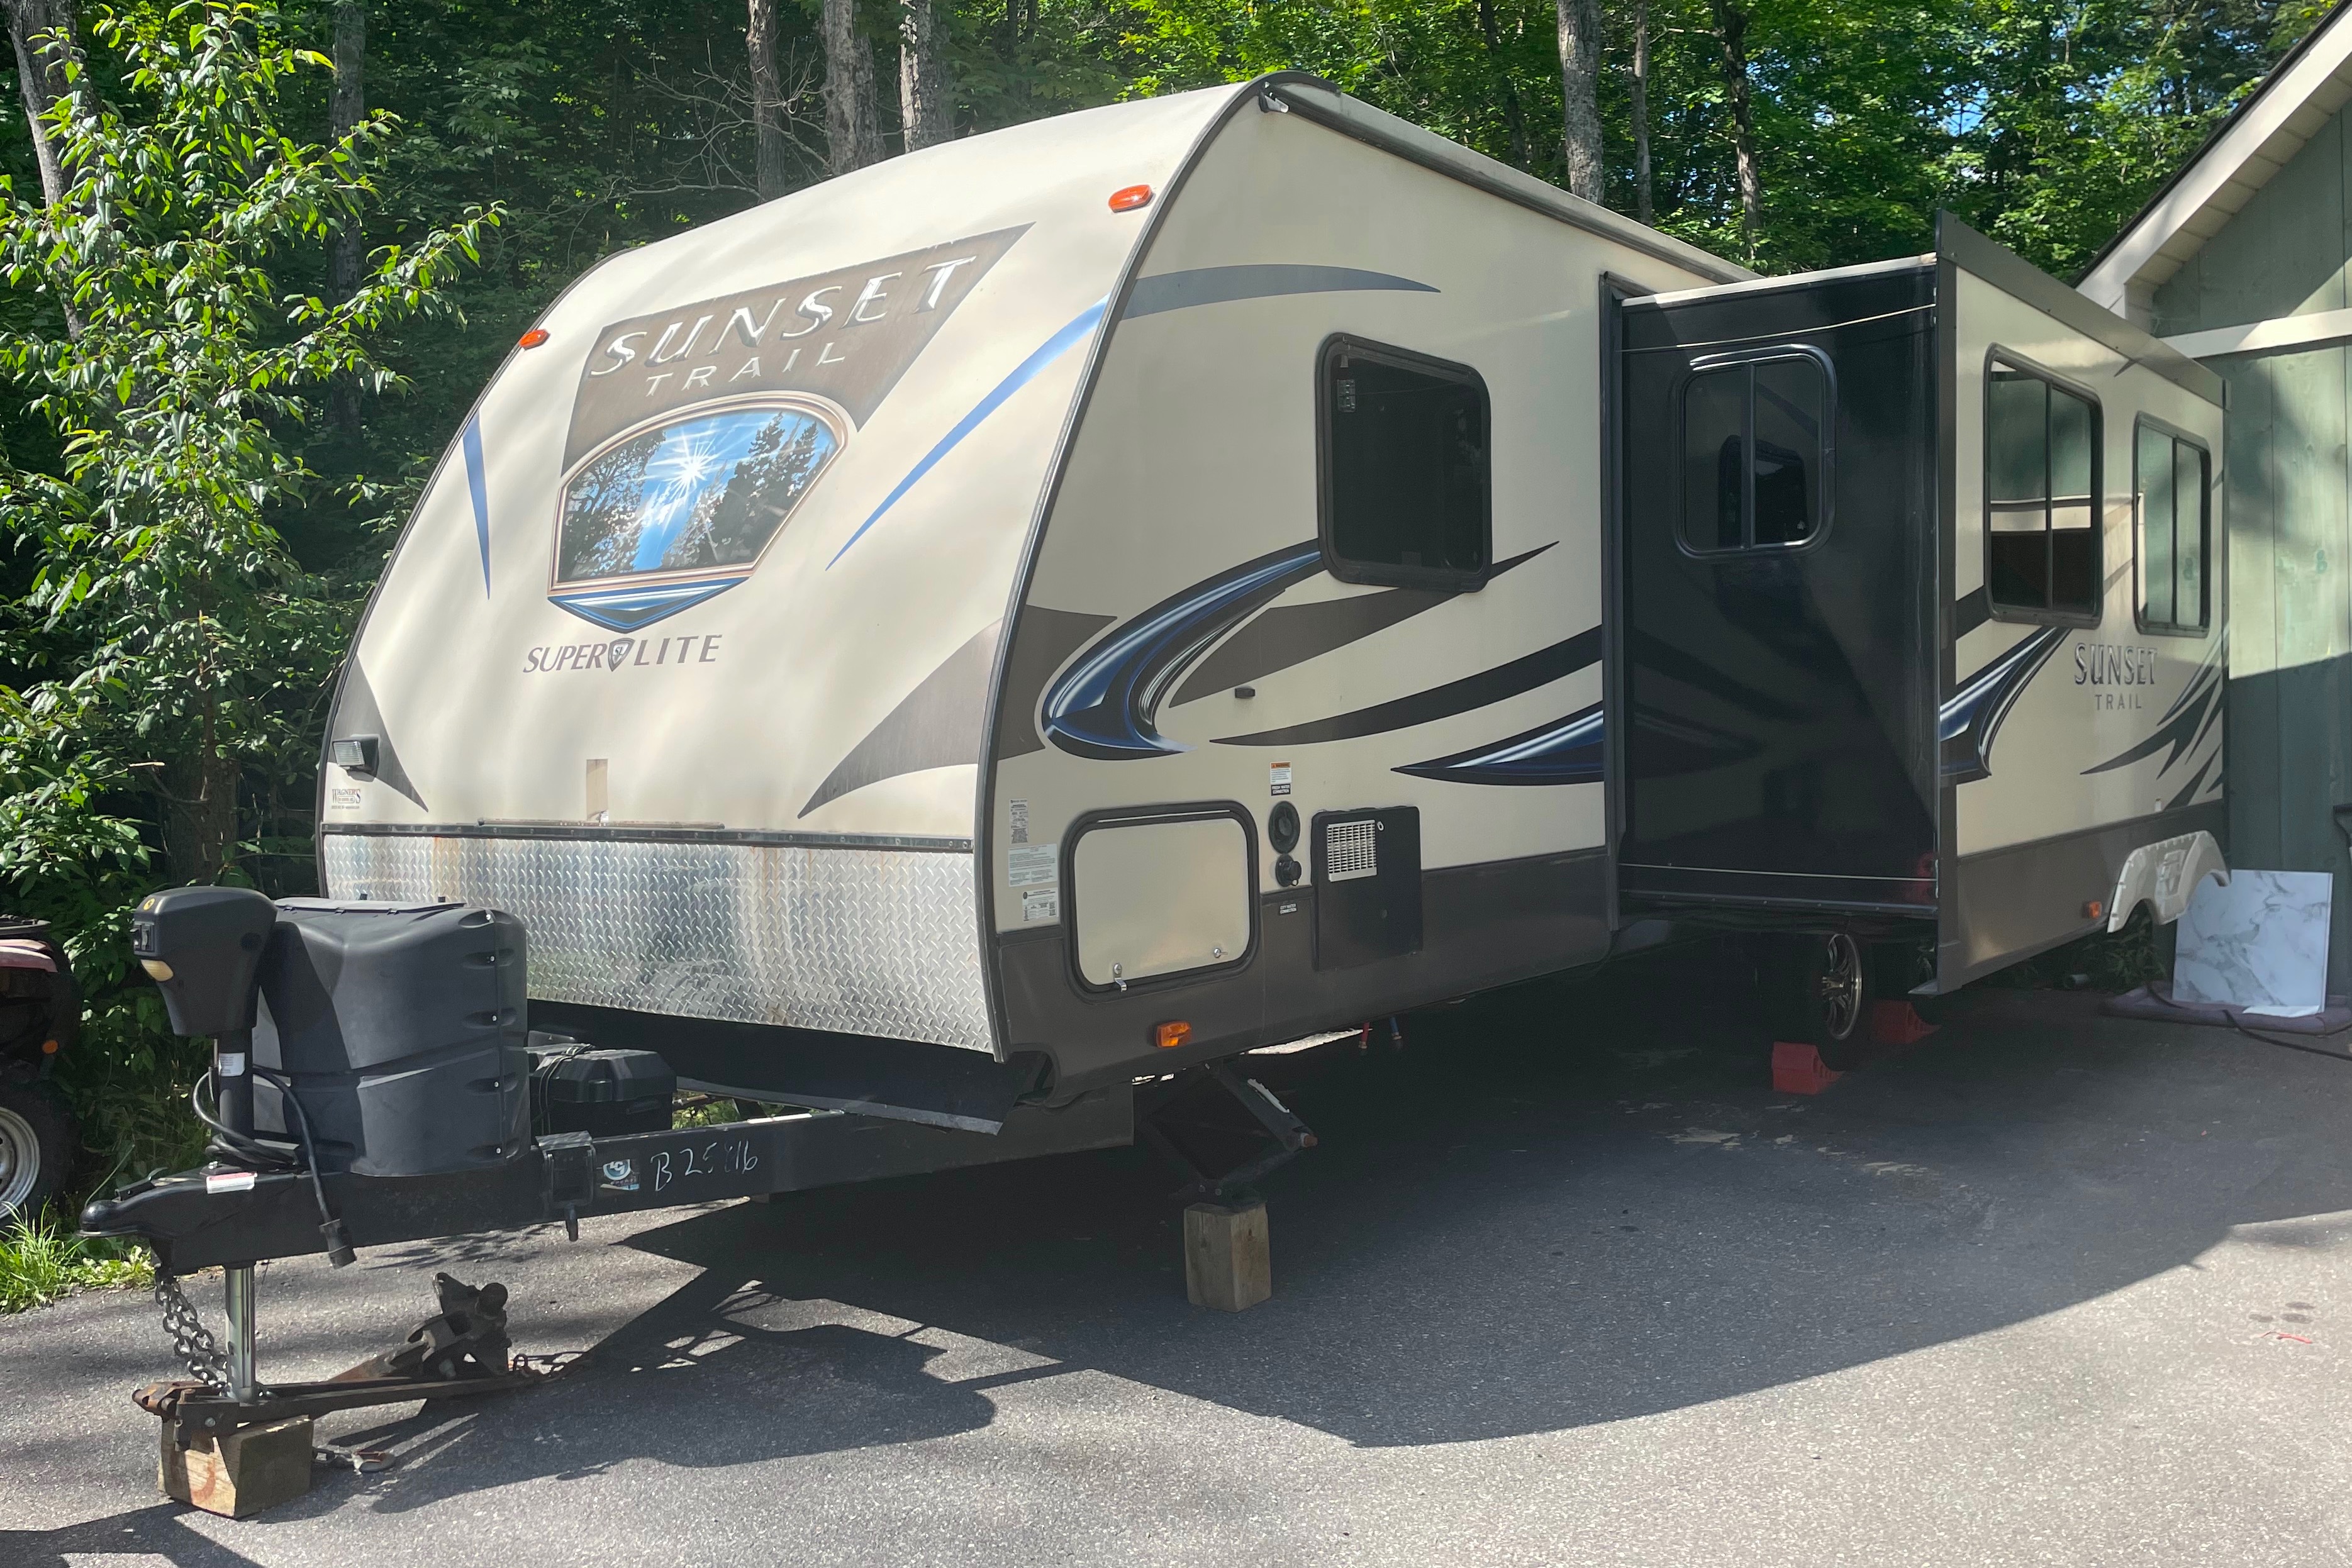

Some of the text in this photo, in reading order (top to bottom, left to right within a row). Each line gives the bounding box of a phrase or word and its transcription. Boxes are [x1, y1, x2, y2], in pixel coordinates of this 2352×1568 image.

[589, 255, 977, 376] SUNSET
[645, 342, 845, 397] TRAIL
[523, 635, 723, 673] SUPER LITE
[2075, 642, 2158, 686] SUNSET
[2094, 692, 2142, 711] TRAIL
